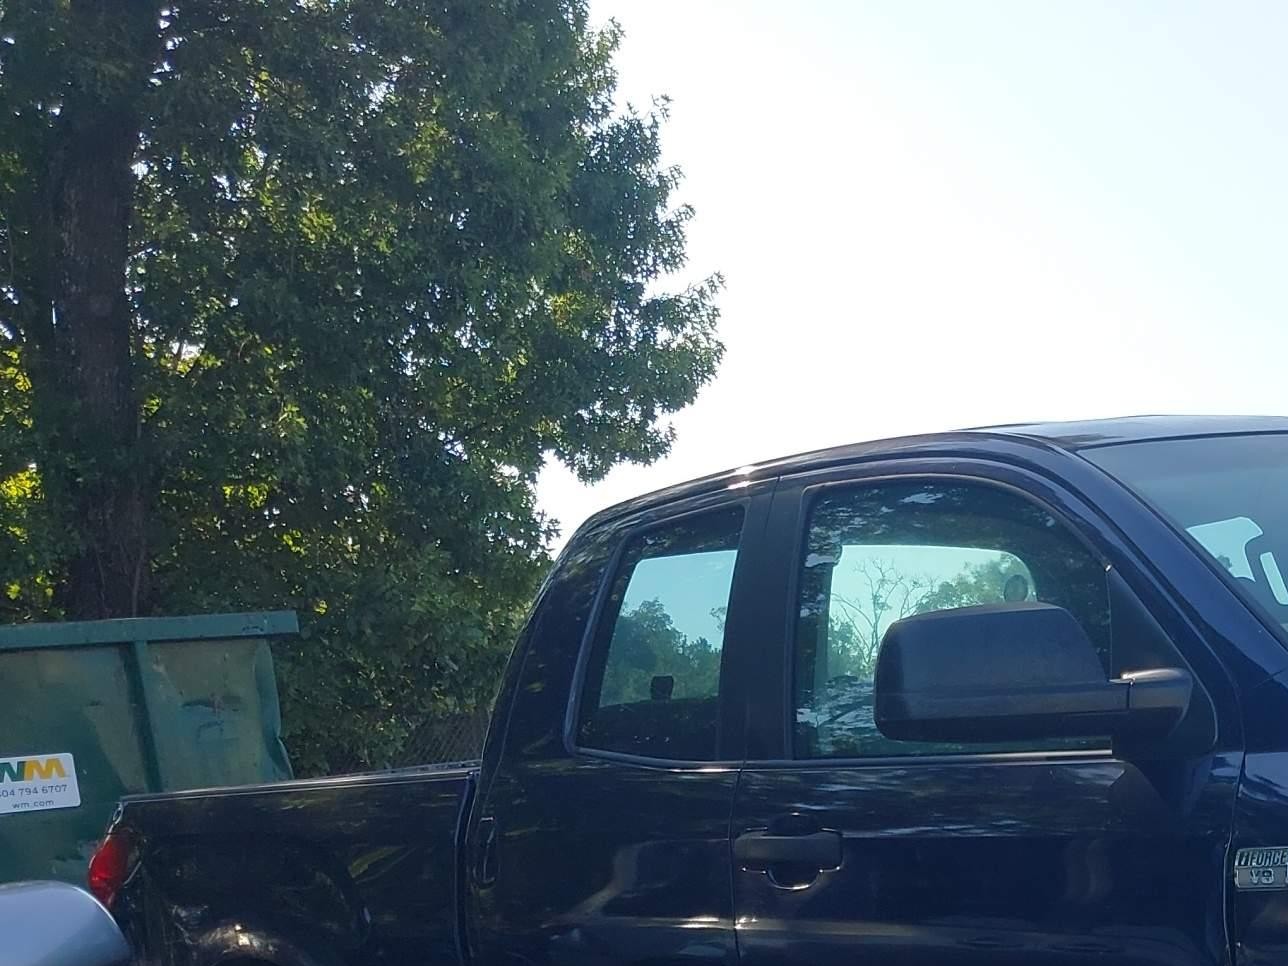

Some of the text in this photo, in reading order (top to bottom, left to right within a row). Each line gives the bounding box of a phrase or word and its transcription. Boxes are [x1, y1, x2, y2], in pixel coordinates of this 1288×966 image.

[0, 784, 67, 797] 04 794 6707
[1250, 868, 1275, 885] V8
